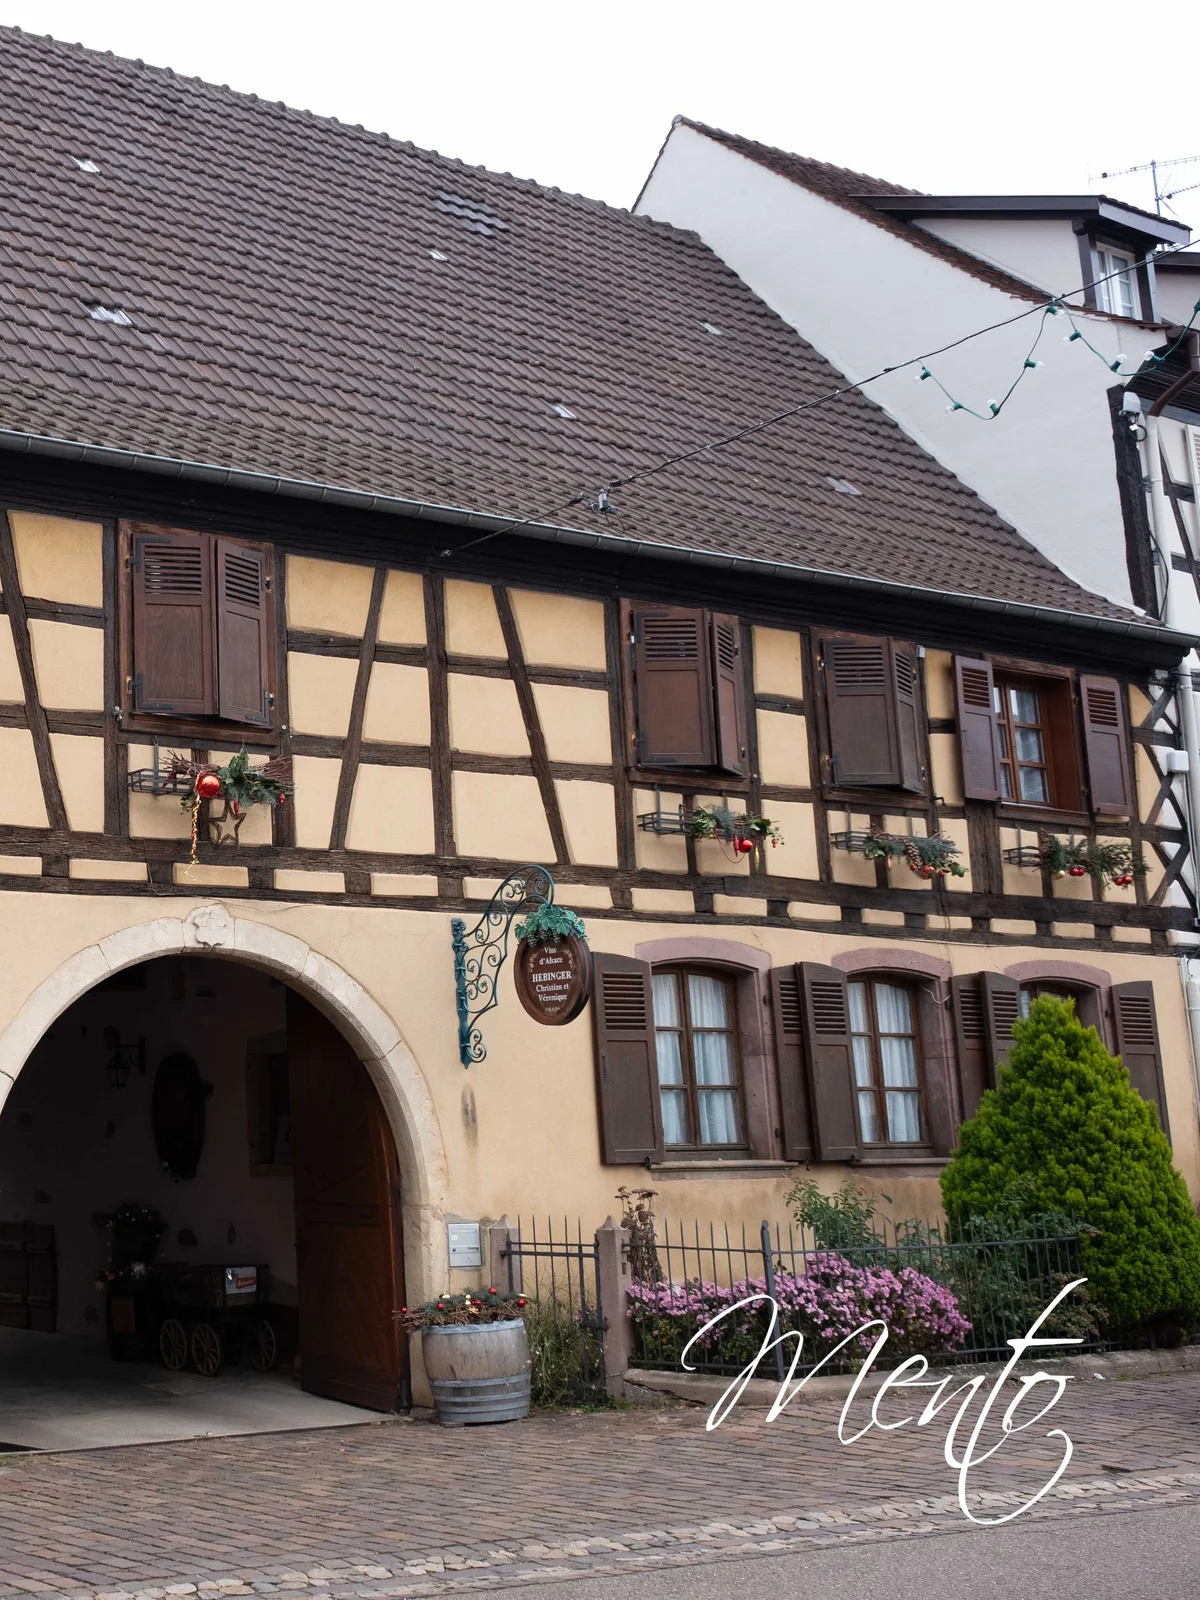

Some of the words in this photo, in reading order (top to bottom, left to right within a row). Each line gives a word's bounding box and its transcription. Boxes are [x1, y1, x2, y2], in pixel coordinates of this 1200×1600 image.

[539, 957, 563, 965] d'Alsace
[532, 970, 572, 982] HEBINGER
[536, 983, 562, 992] Christian
[538, 993, 567, 1002] Véronique
